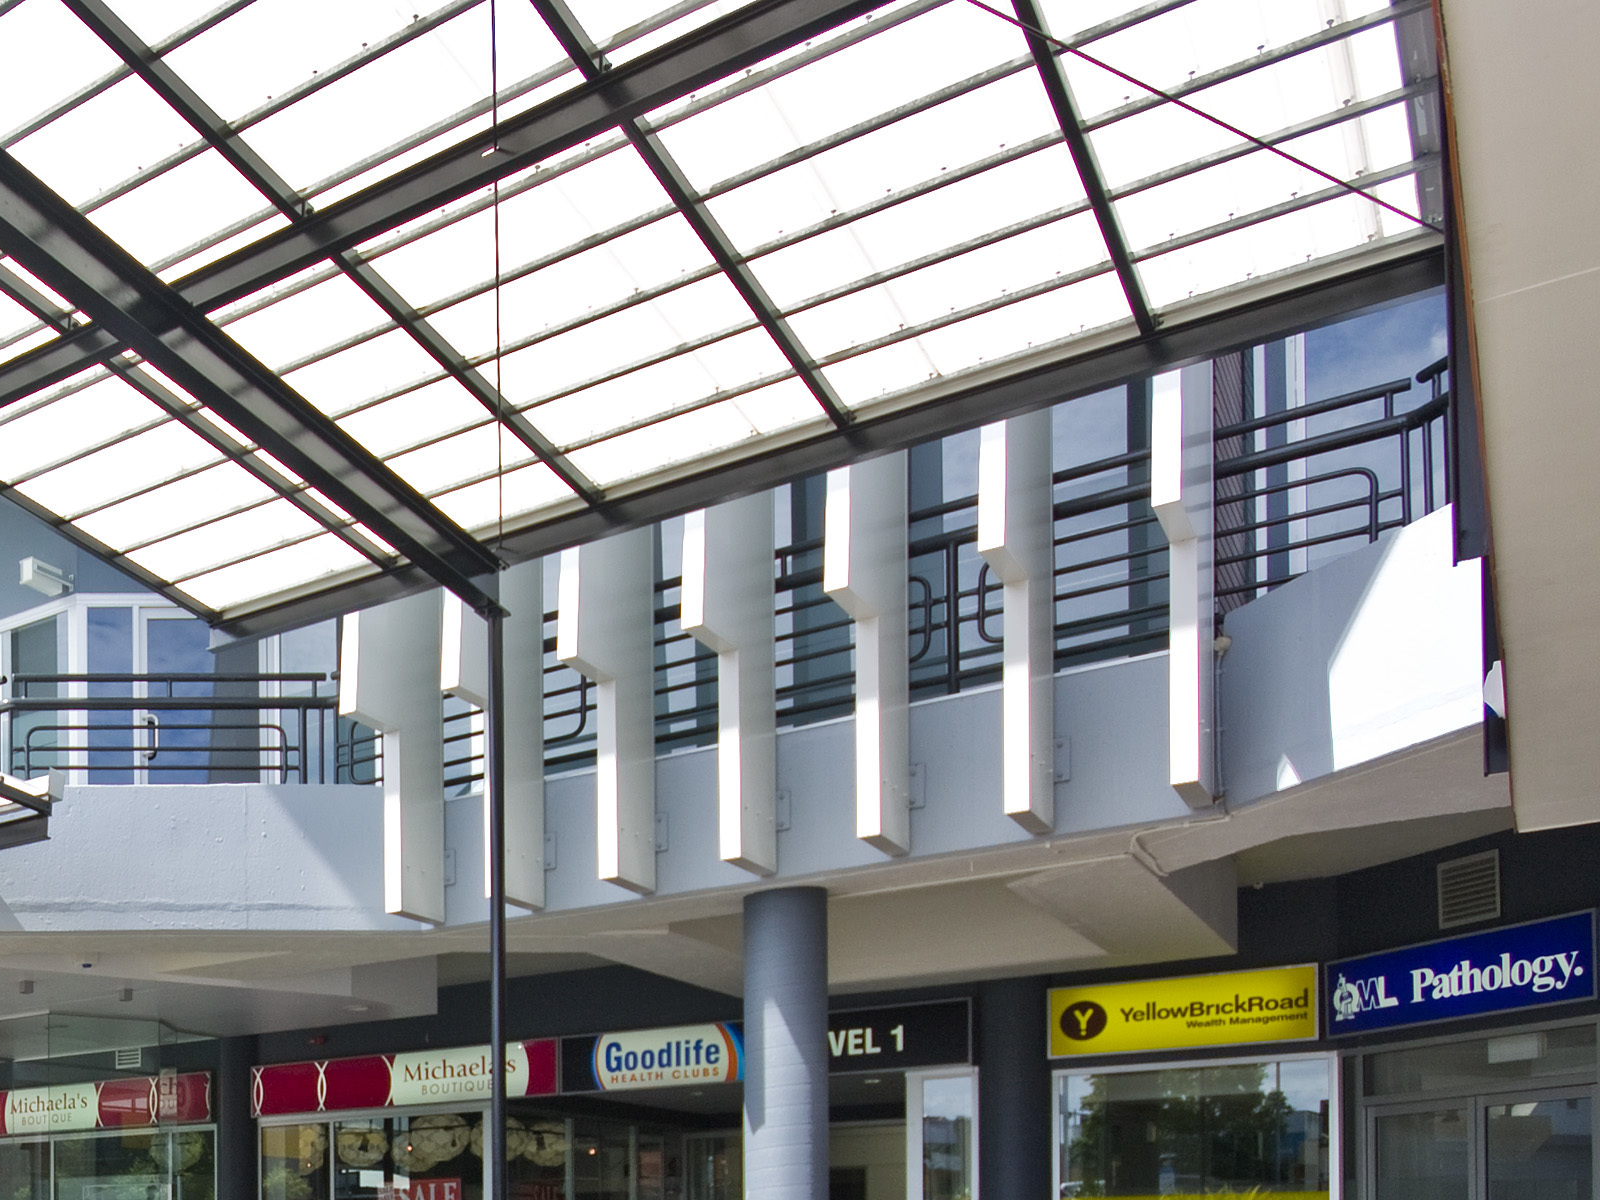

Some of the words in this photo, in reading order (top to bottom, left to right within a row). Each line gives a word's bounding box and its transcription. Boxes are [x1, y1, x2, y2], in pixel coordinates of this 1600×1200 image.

[1409, 950, 1584, 1003] Pathology.
[1120, 987, 1309, 1023] YellowBrickRoad
[1185, 1018, 1226, 1029] Wealth
[1229, 1012, 1308, 1027] Management
[890, 1024, 904, 1052] 1
[605, 1038, 721, 1073] Goodlife
[610, 1072, 664, 1084] HEALTH
[671, 1067, 720, 1080] CLUBS
[9, 1093, 88, 1115] Michaela's
